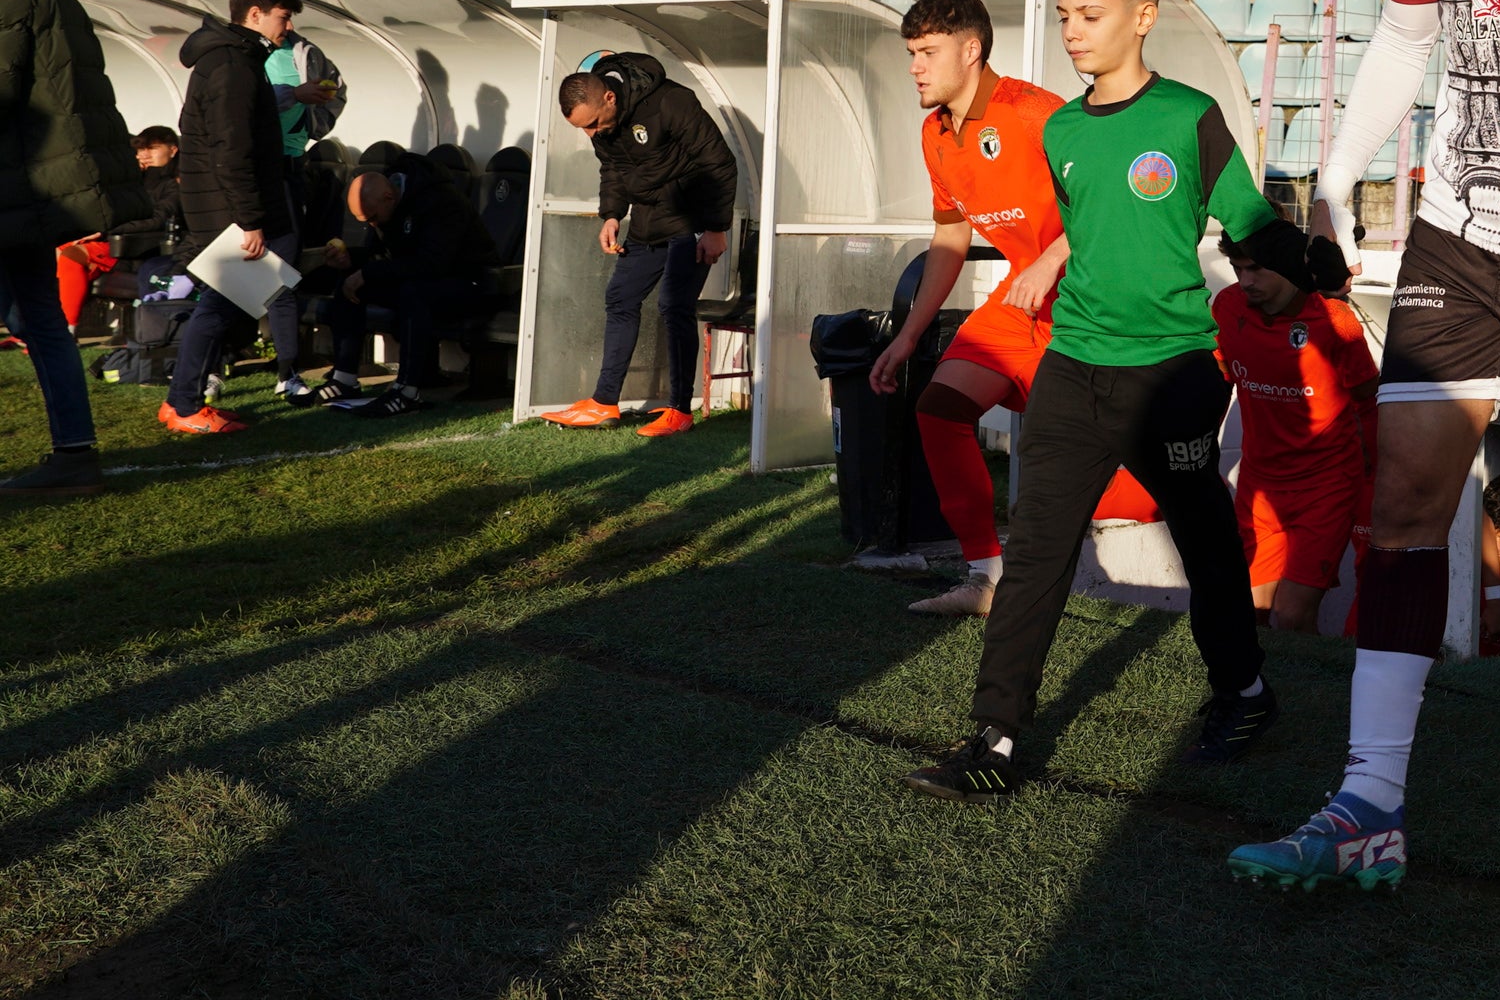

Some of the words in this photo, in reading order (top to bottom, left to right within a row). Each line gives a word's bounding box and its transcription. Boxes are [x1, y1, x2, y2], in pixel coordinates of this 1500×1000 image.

[1397, 296, 1444, 309] Salamanca
[1163, 429, 1215, 463] 1986
[1169, 462, 1196, 472] SPORT
